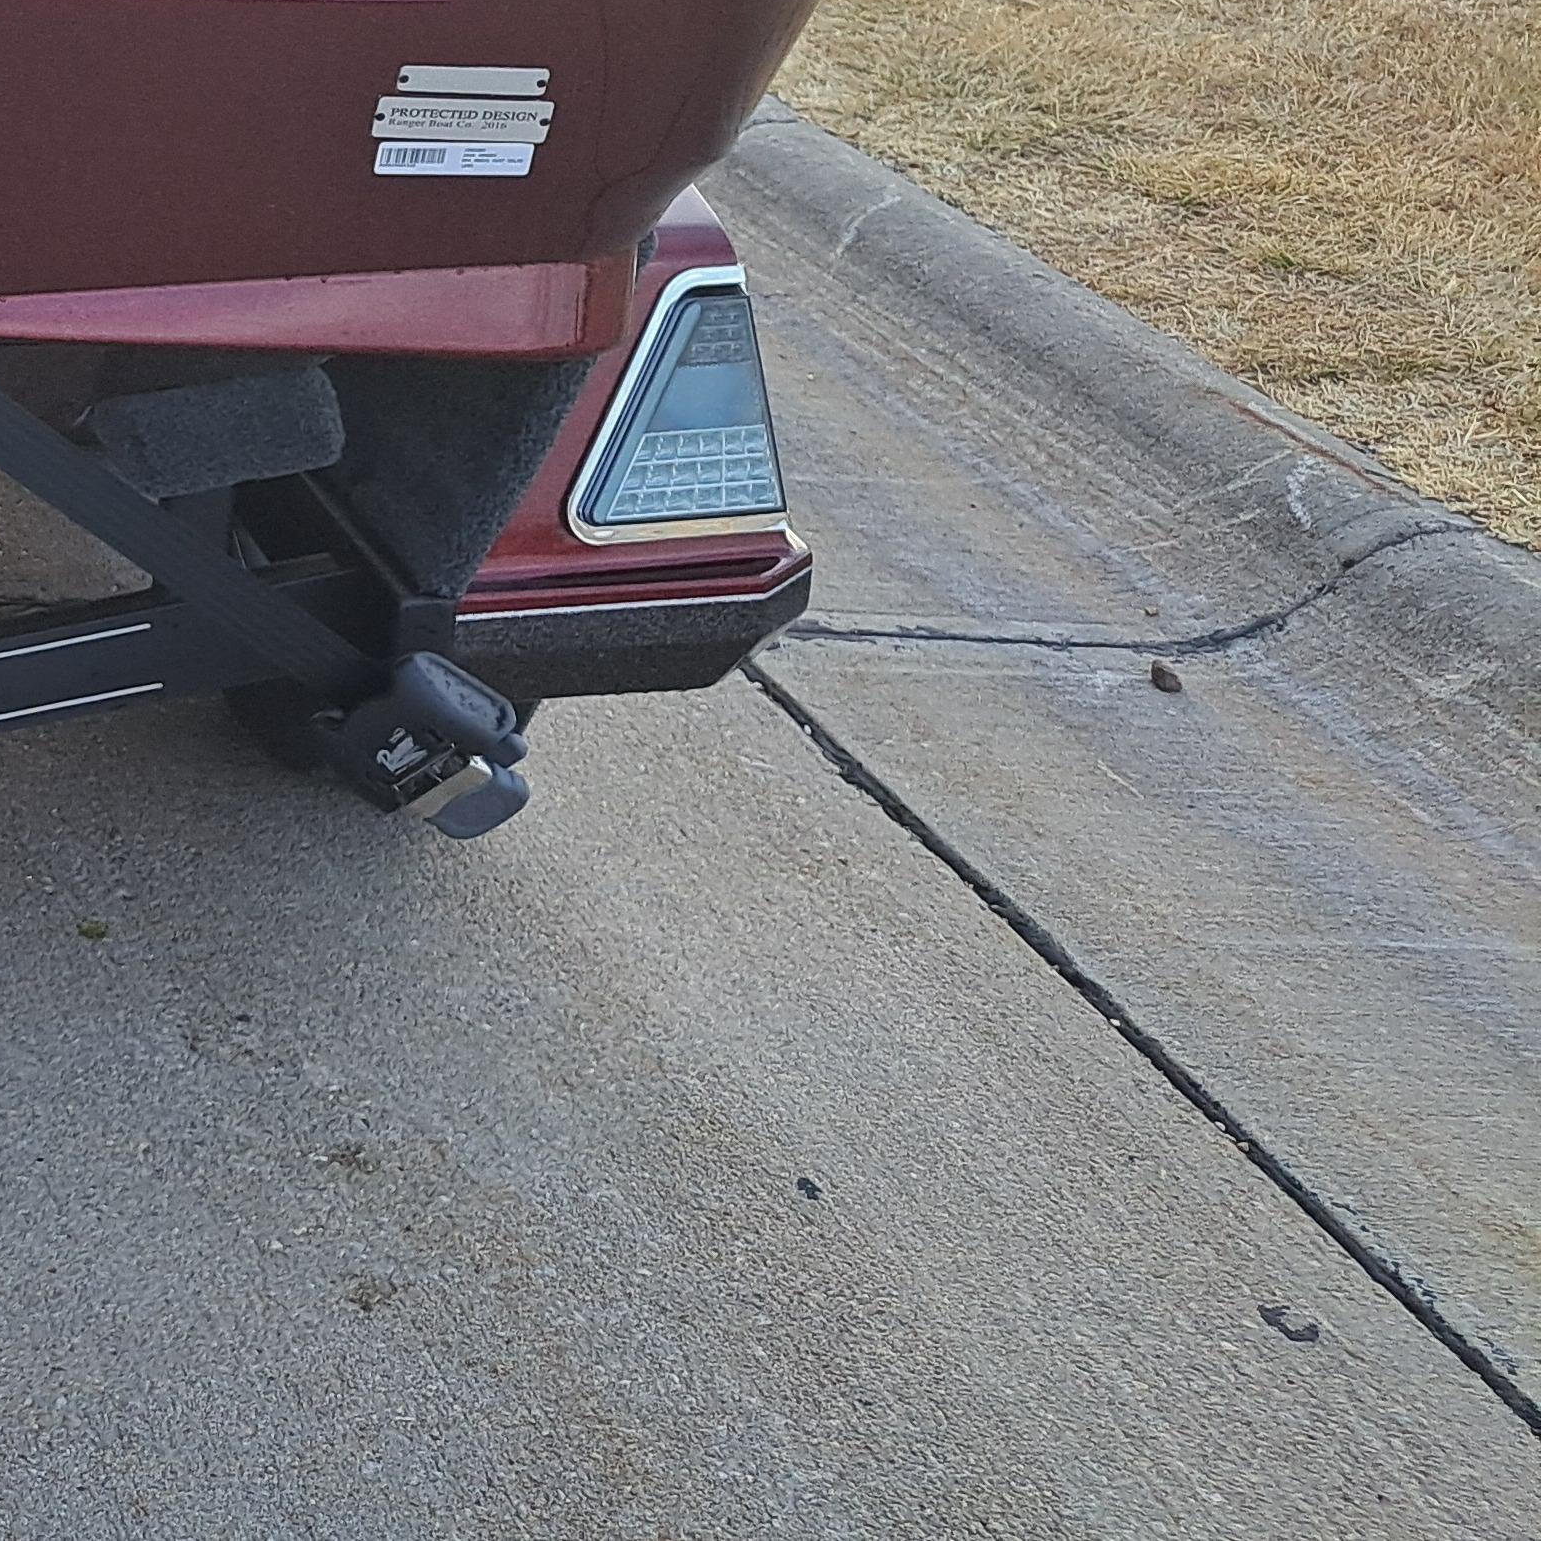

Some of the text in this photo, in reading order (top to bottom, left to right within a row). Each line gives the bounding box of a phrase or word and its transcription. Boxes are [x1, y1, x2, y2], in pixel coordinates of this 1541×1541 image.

[390, 107, 538, 122] PROTECTED DESIGN
[388, 118, 426, 128] Ranger
[428, 119, 453, 128] Boat
